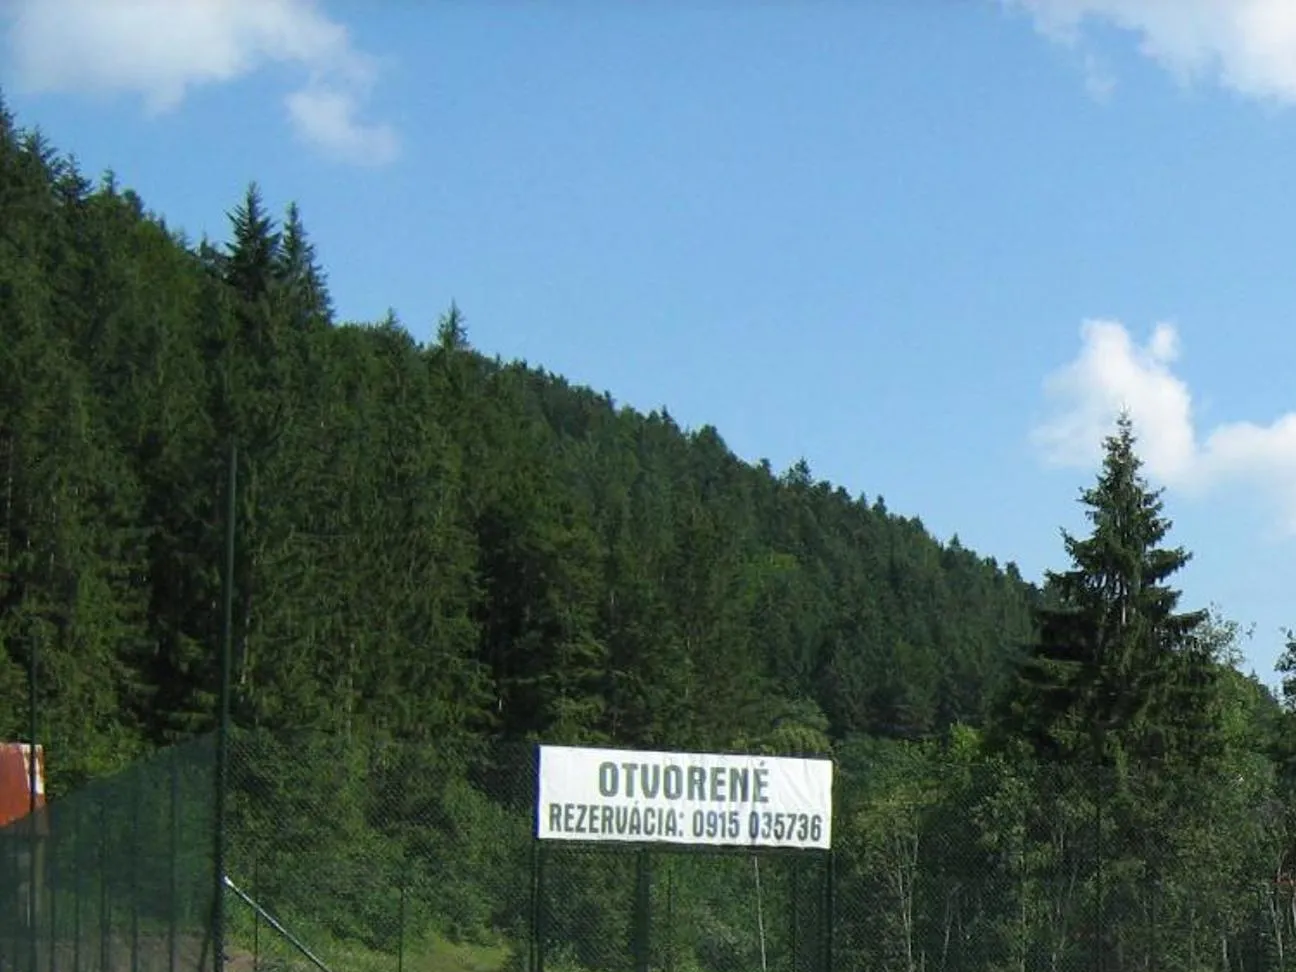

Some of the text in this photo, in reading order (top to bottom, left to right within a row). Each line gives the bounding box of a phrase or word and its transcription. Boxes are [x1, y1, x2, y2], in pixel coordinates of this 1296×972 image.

[599, 760, 769, 803] OTVORENÉ
[549, 800, 823, 842] REZERVÁCIA: 0915 035736
